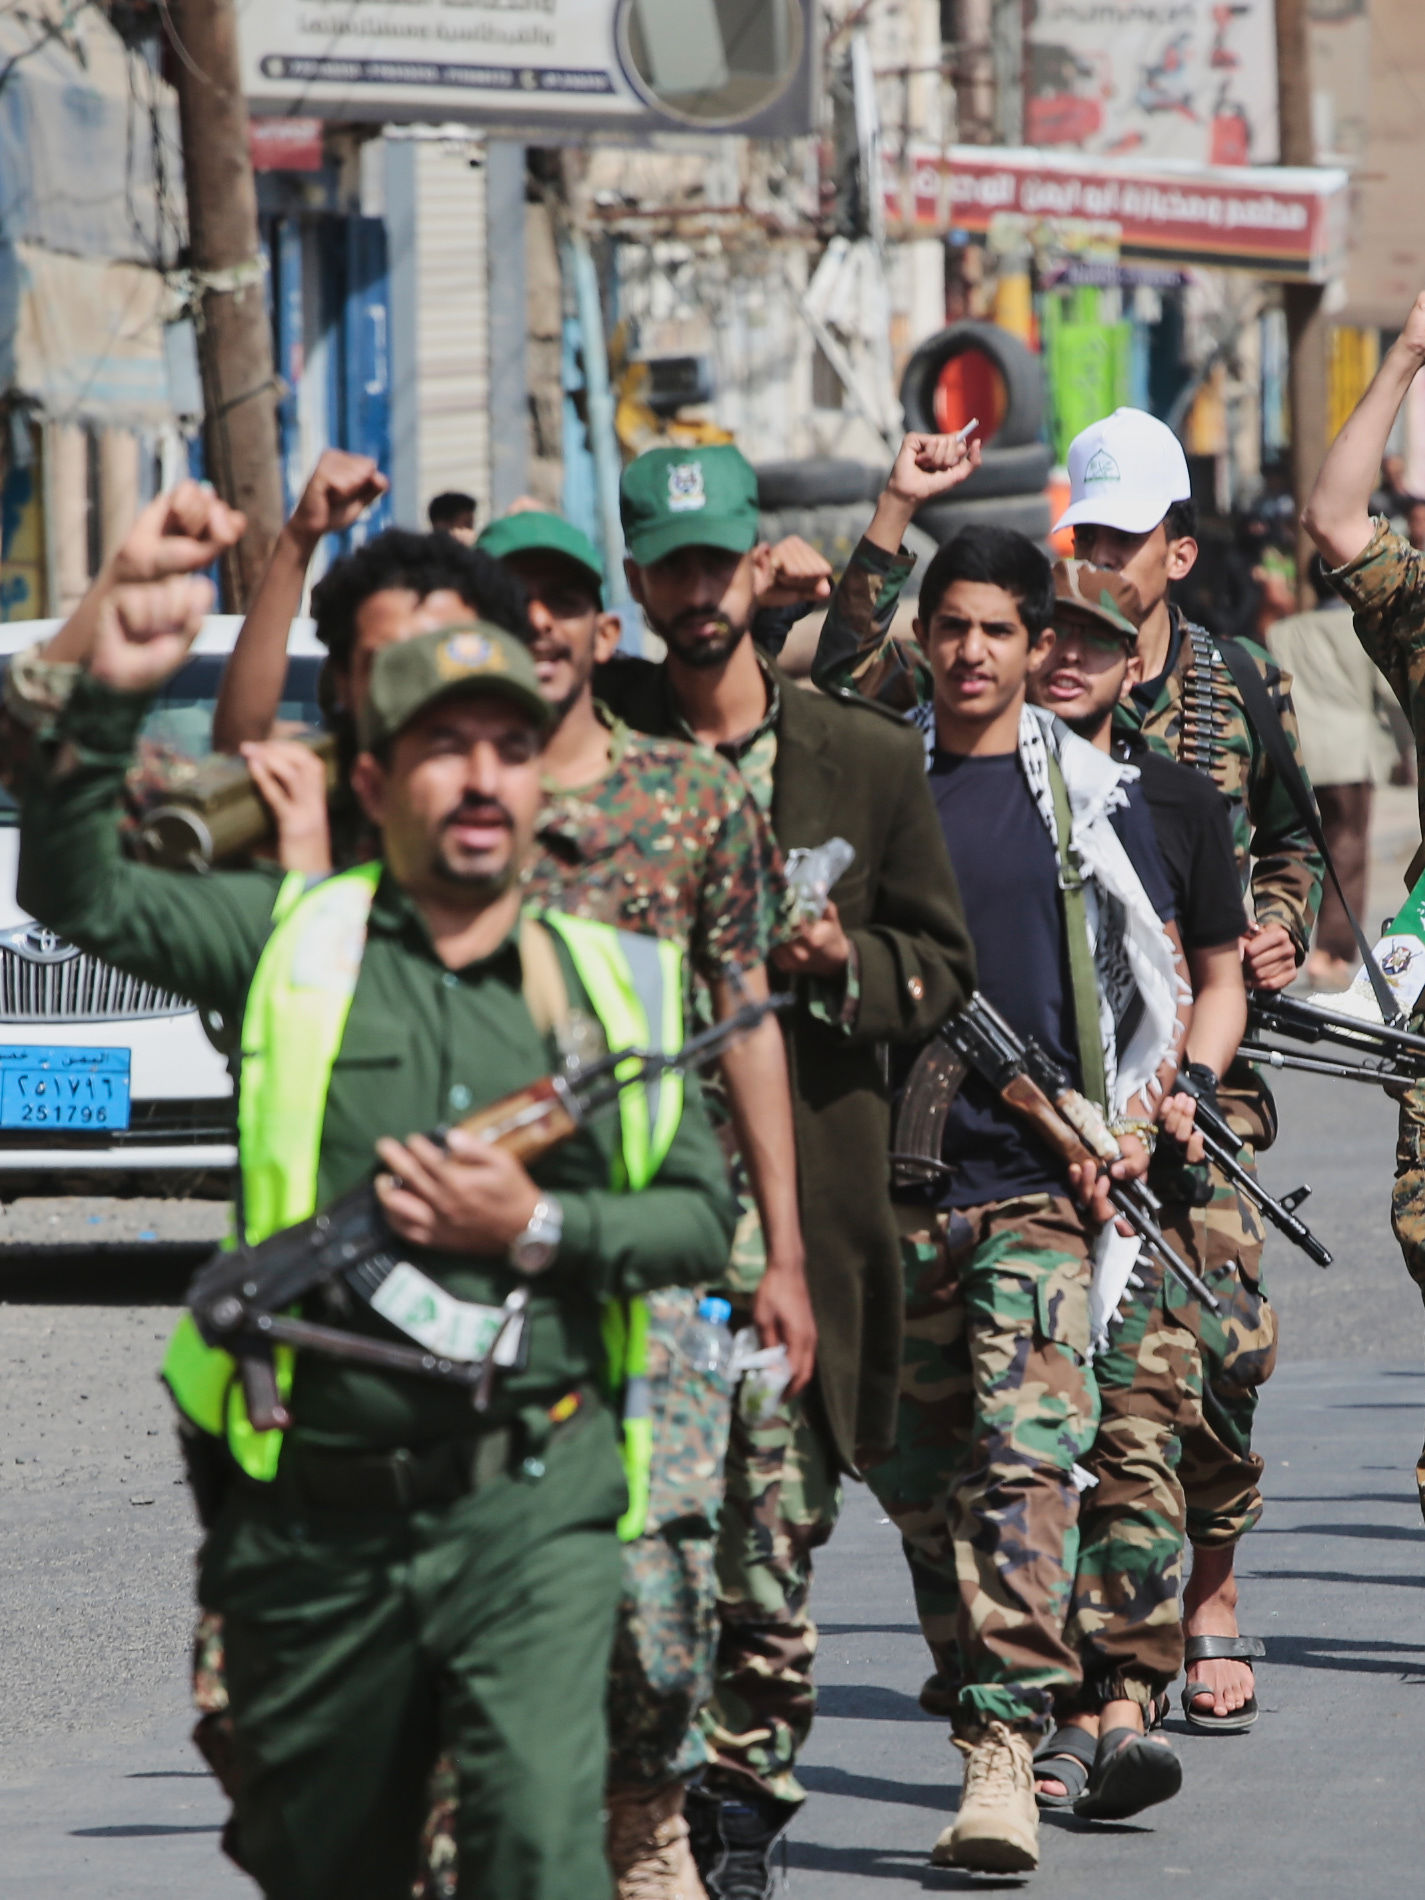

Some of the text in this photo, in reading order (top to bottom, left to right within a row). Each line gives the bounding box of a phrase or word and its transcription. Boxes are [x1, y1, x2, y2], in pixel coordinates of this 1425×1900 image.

[62, 1053, 109, 1067] اليمن
[18, 1074, 112, 1100] ٢٥١٧٩٦
[22, 1104, 107, 1123] 251796
